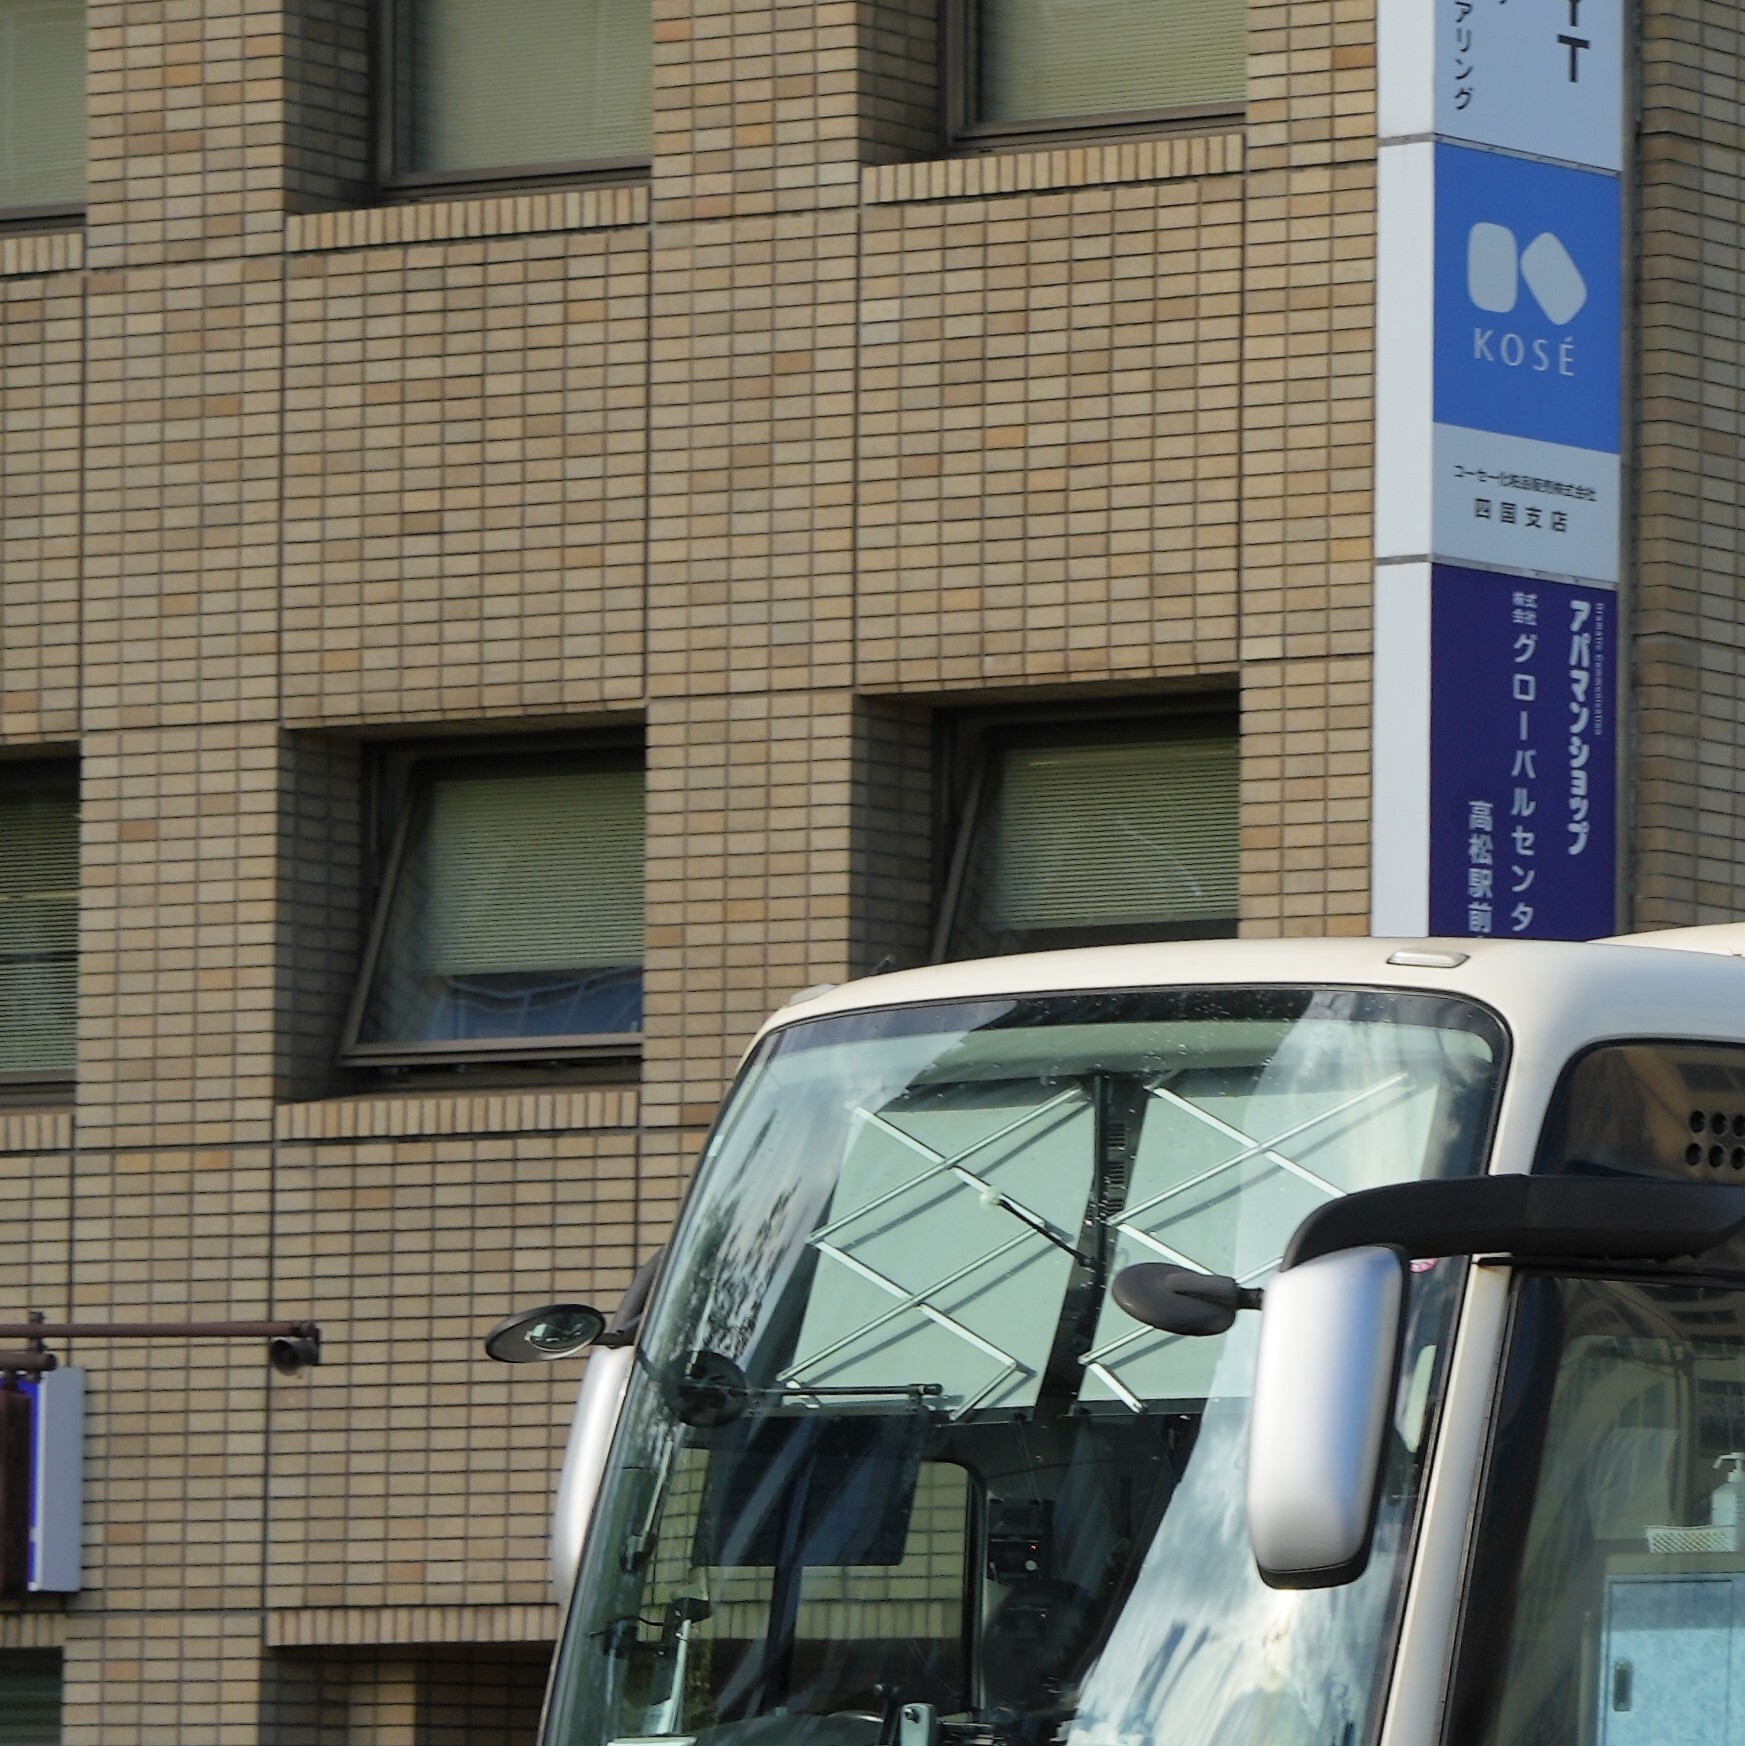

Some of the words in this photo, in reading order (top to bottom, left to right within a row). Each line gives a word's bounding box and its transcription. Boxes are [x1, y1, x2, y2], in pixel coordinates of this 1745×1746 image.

[1473, 327, 1576, 377] KOSÉ
[1475, 497, 1568, 533] 四国支店
[1567, 600, 1592, 856] アパマンショップ
[1467, 800, 1494, 938] 高松駅前
